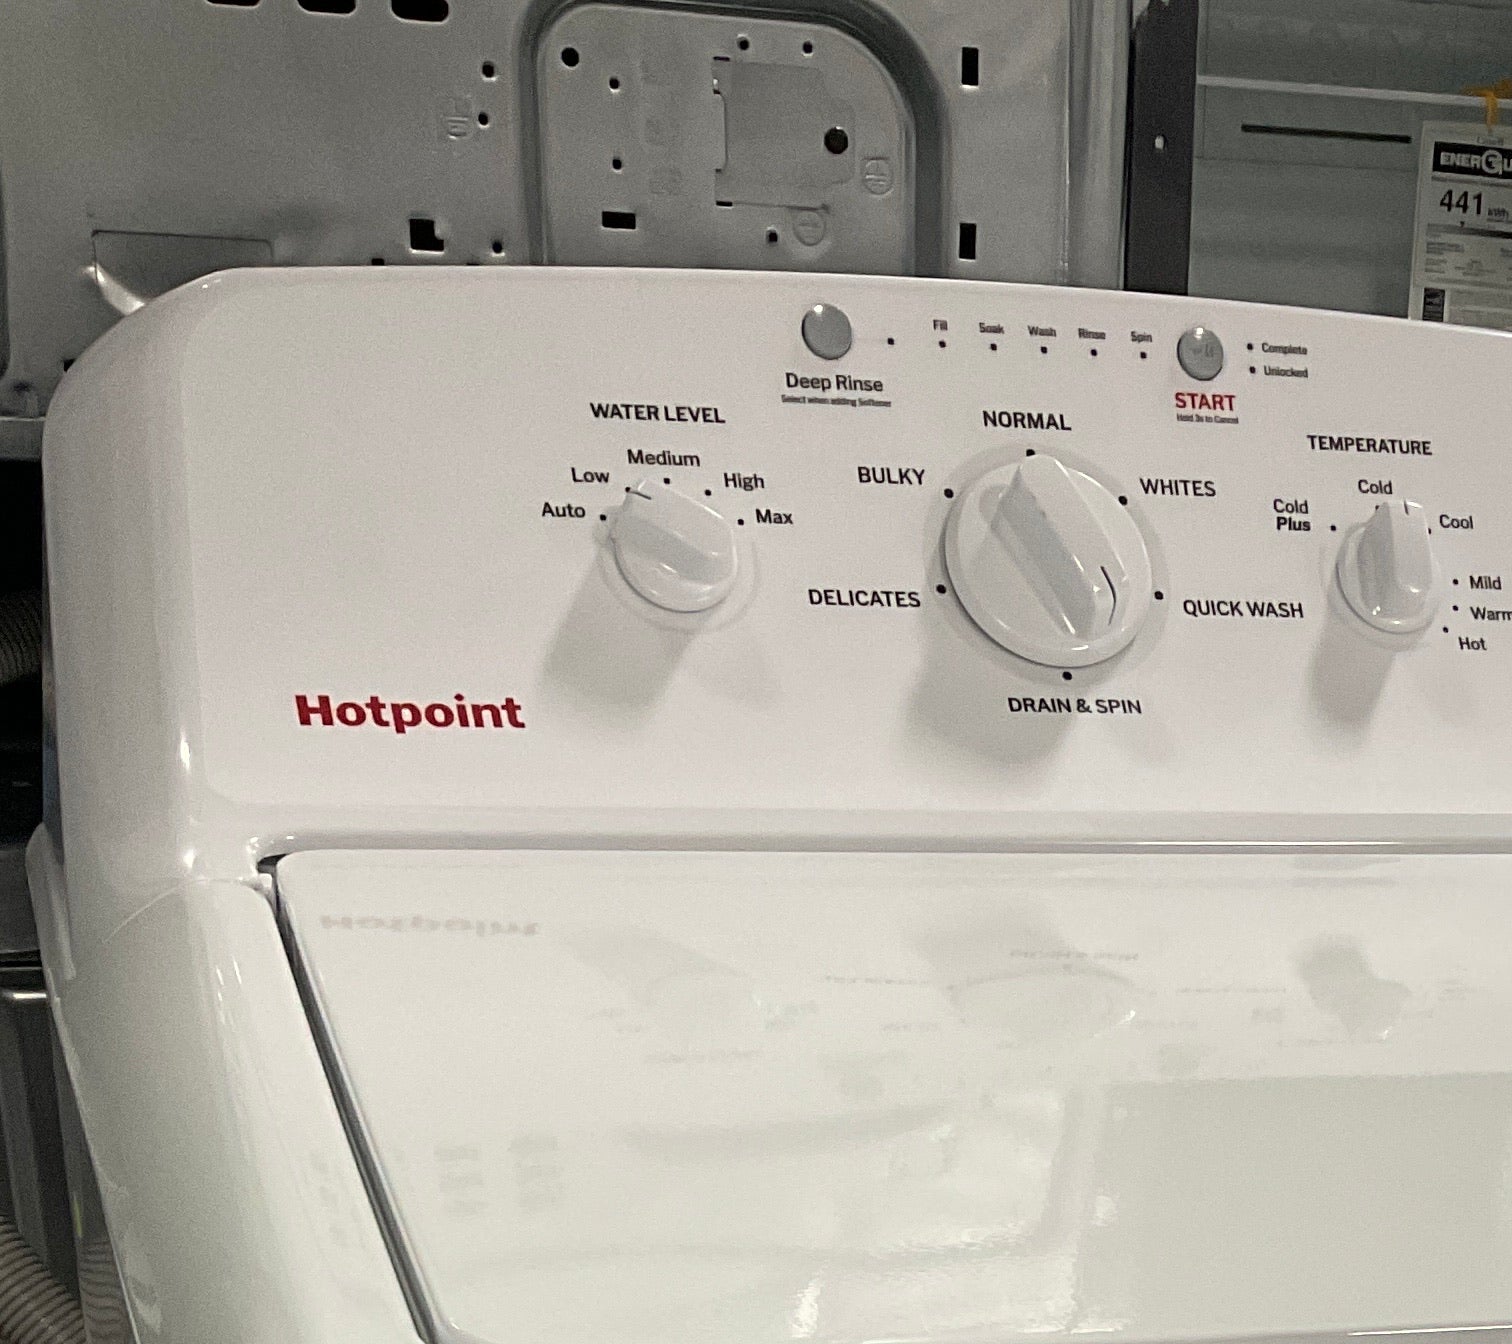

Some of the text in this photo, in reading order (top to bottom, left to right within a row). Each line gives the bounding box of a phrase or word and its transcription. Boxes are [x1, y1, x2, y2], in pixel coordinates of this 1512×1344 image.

[1439, 189, 1483, 215] 441
[933, 320, 948, 331] Fill
[979, 322, 1004, 334] Soak
[1028, 326, 1056, 337] Wash
[1078, 328, 1106, 340] Rinse
[1131, 331, 1152, 343] Spin
[1262, 343, 1307, 355] Complete
[1264, 365, 1308, 378] Unlocked
[786, 373, 883, 392] Deep Rinse
[1175, 392, 1235, 411] START
[590, 403, 725, 423] WATER LEVEL
[983, 411, 1071, 431] NORMAL
[1176, 412, 1193, 422] Hold
[1205, 414, 1213, 423] to
[1214, 414, 1239, 424] Cancel
[1307, 435, 1432, 455] TEMPERATURE
[627, 449, 700, 466] Medium
[571, 467, 609, 483] Low
[724, 473, 764, 491] High
[858, 467, 924, 485] BULKY
[1140, 478, 1216, 496] WHITES
[1358, 480, 1392, 494] Cold
[542, 502, 585, 518] Auto
[1274, 499, 1308, 514] Cold
[756, 509, 793, 524] Max
[1277, 516, 1310, 531] Plus
[1440, 514, 1473, 529] Cool
[1470, 576, 1501, 590] Mild
[808, 589, 920, 607] DELICATES
[1183, 600, 1303, 618] QUICK WASH
[1459, 637, 1487, 650] Hot
[295, 694, 525, 734] Hotpoint
[1008, 698, 1142, 714] DRAIN & SPIN
